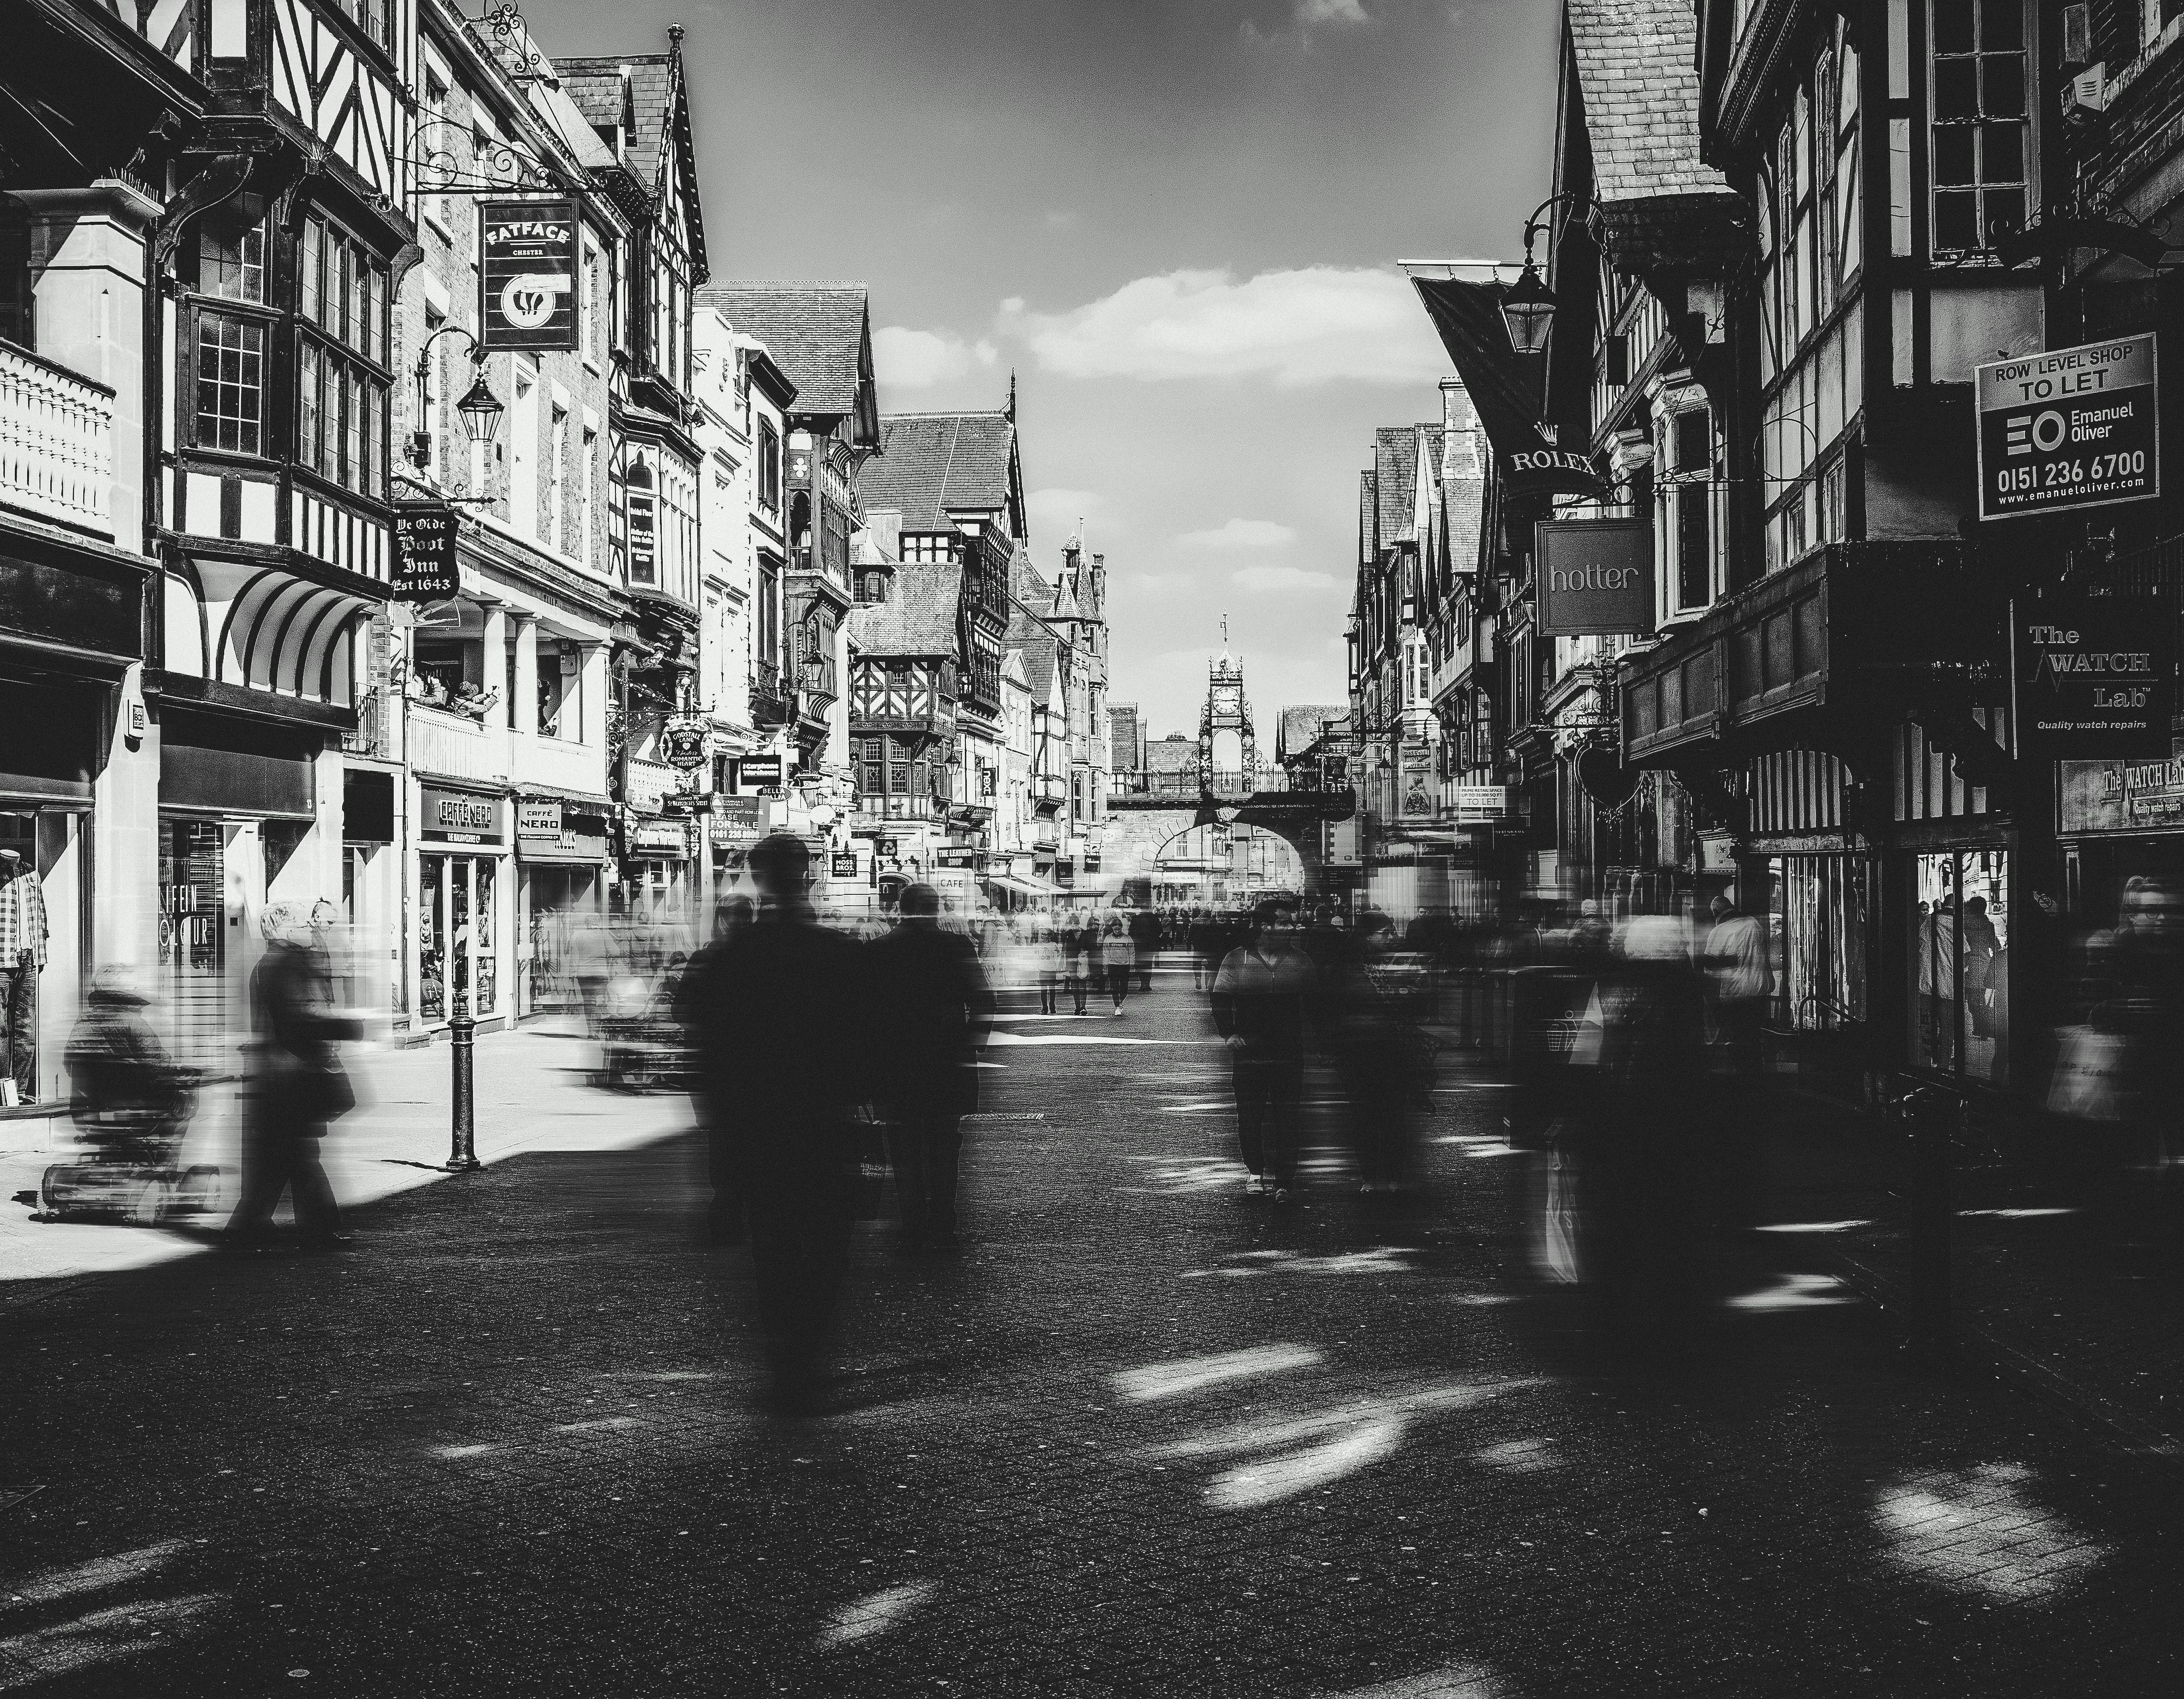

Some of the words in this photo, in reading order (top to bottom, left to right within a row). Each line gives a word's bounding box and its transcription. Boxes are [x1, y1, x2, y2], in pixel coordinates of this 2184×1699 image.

[486, 222, 570, 245] FATFACE
[1996, 363, 2030, 382] ROW
[2038, 354, 2086, 375] LEVEL
[2089, 345, 2133, 365] SHOP
[2019, 379, 2053, 401] TO
[2061, 369, 2109, 395] LET
[2071, 402, 2133, 425] Emanuel
[2071, 425, 2112, 442] Oliver
[1510, 451, 1597, 474] ROLEX
[1998, 466, 2037, 492] 0151
[2045, 459, 2083, 486] 236
[2091, 450, 2144, 479] 6700
[1999, 478, 2144, 505] www.emanueloliver.com
[396, 519, 412, 534] Ye
[416, 518, 445, 530] Olde
[398, 535, 445, 555] Boot
[403, 551, 439, 573] Inn
[392, 579, 413, 591] Est
[418, 578, 451, 590] 1643
[1551, 564, 1639, 591] hotter
[2029, 626, 2080, 644] The
[2048, 653, 2150, 672] WATCH
[2038, 721, 2074, 730] Quality
[2111, 720, 2147, 730] repairs
[673, 731, 700, 741] GODSTALL
[2103, 770, 2121, 791] The
[2125, 764, 2163, 788] WATCH
[307, 798, 312, 810] 13
[2134, 801, 2150, 815] Quality
[2151, 802, 2164, 813] watch
[2165, 802, 2181, 814] repairs
[520, 819, 558, 829] NERO
[711, 820, 731, 828] FOR
[710, 829, 727, 838] 0161
[938, 850, 949, 858] THE
[949, 849, 972, 857] LEATHER
[948, 857, 963, 866] SHOP
[940, 879, 963, 888] CAFE
